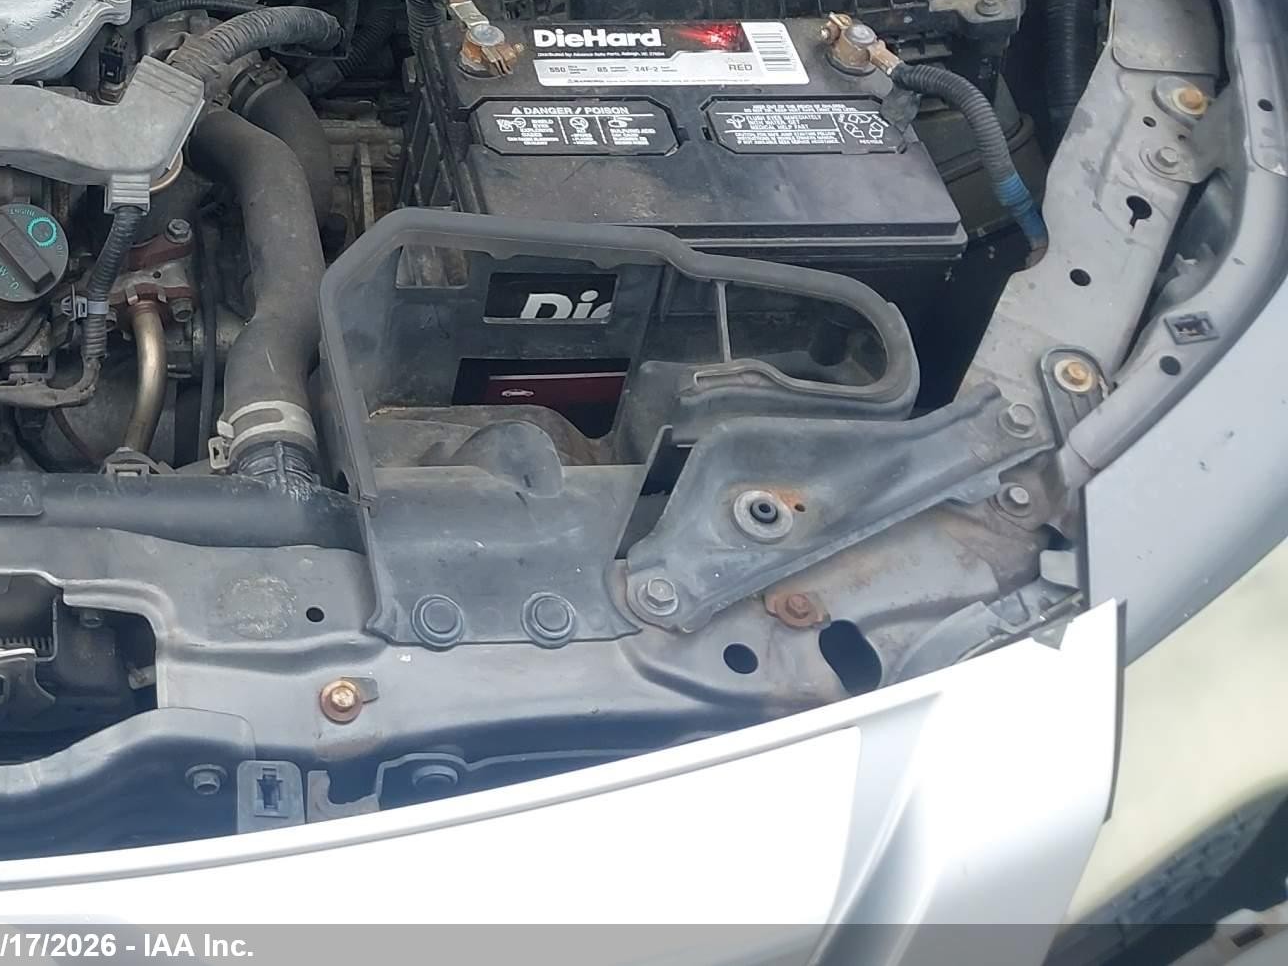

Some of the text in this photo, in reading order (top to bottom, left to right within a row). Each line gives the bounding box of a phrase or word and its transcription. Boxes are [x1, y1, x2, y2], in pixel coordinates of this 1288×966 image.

[533, 28, 662, 47] DieHard
[728, 63, 753, 71] RED
[523, 107, 572, 115] DANGER
